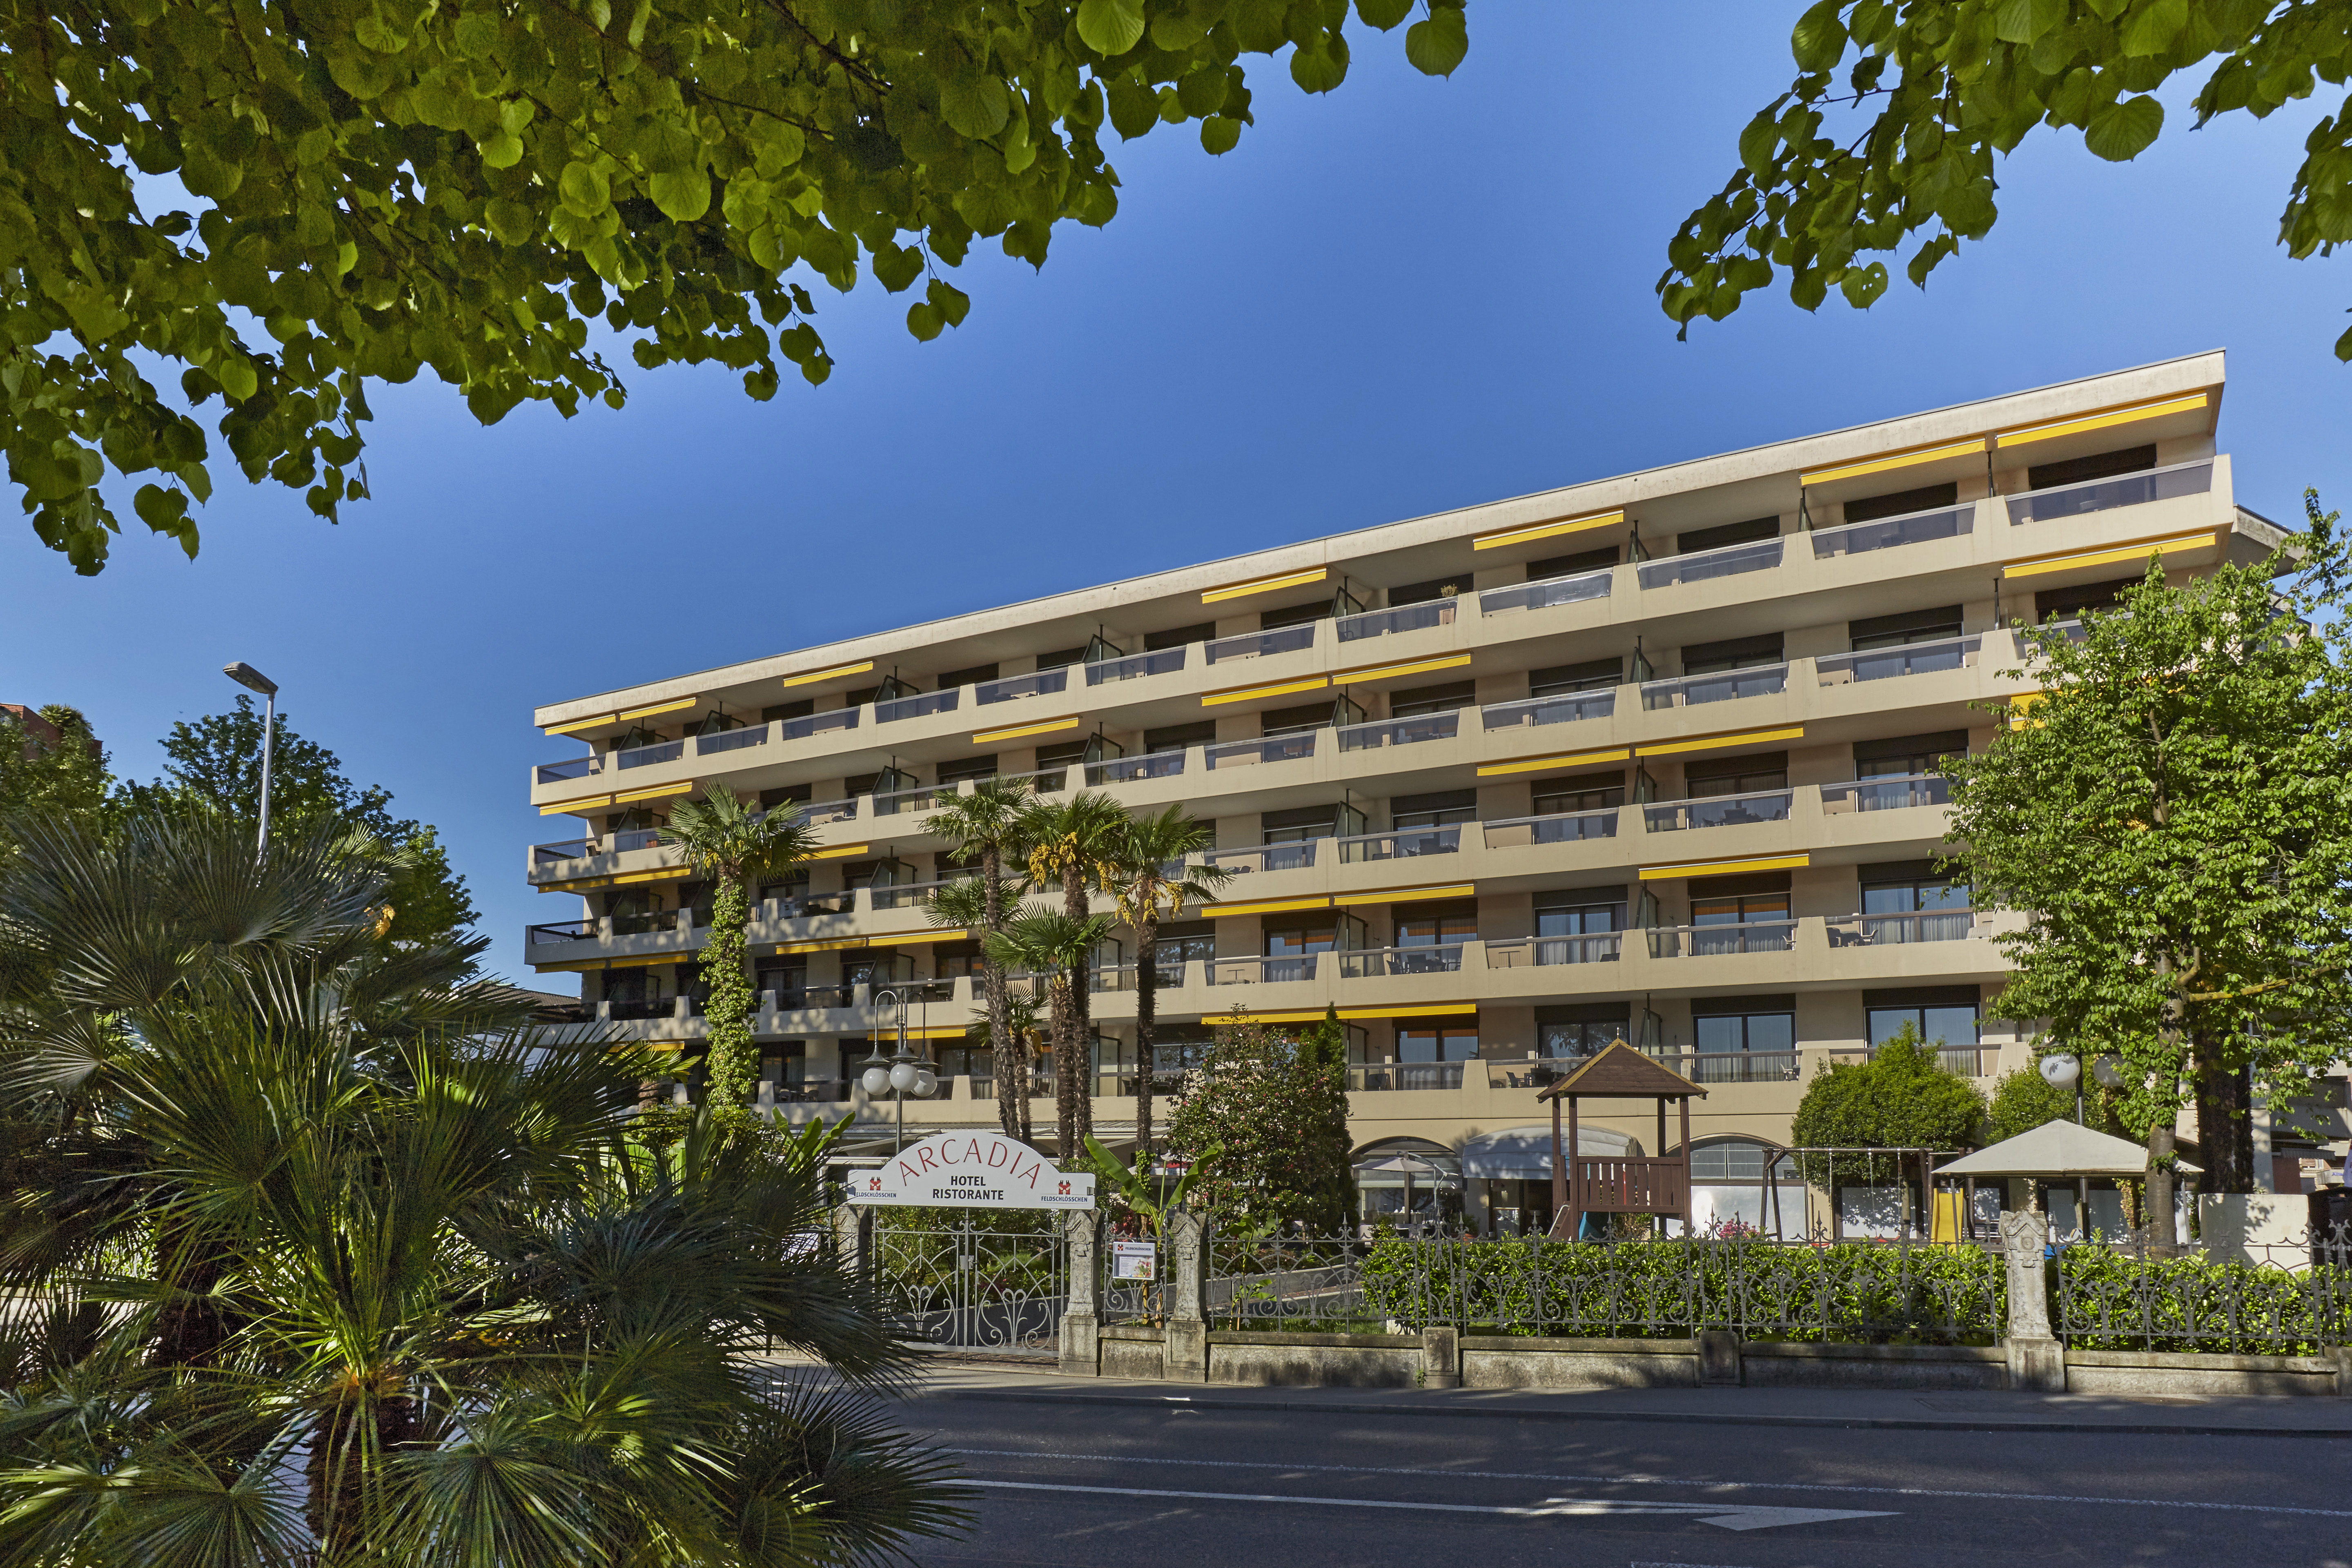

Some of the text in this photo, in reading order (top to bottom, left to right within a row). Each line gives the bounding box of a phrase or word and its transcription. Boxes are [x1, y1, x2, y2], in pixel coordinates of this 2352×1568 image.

[899, 1138, 1040, 1189] ARCADIA
[951, 1176, 986, 1186] HOTEL
[933, 1189, 1004, 1200] RISTORANTE
